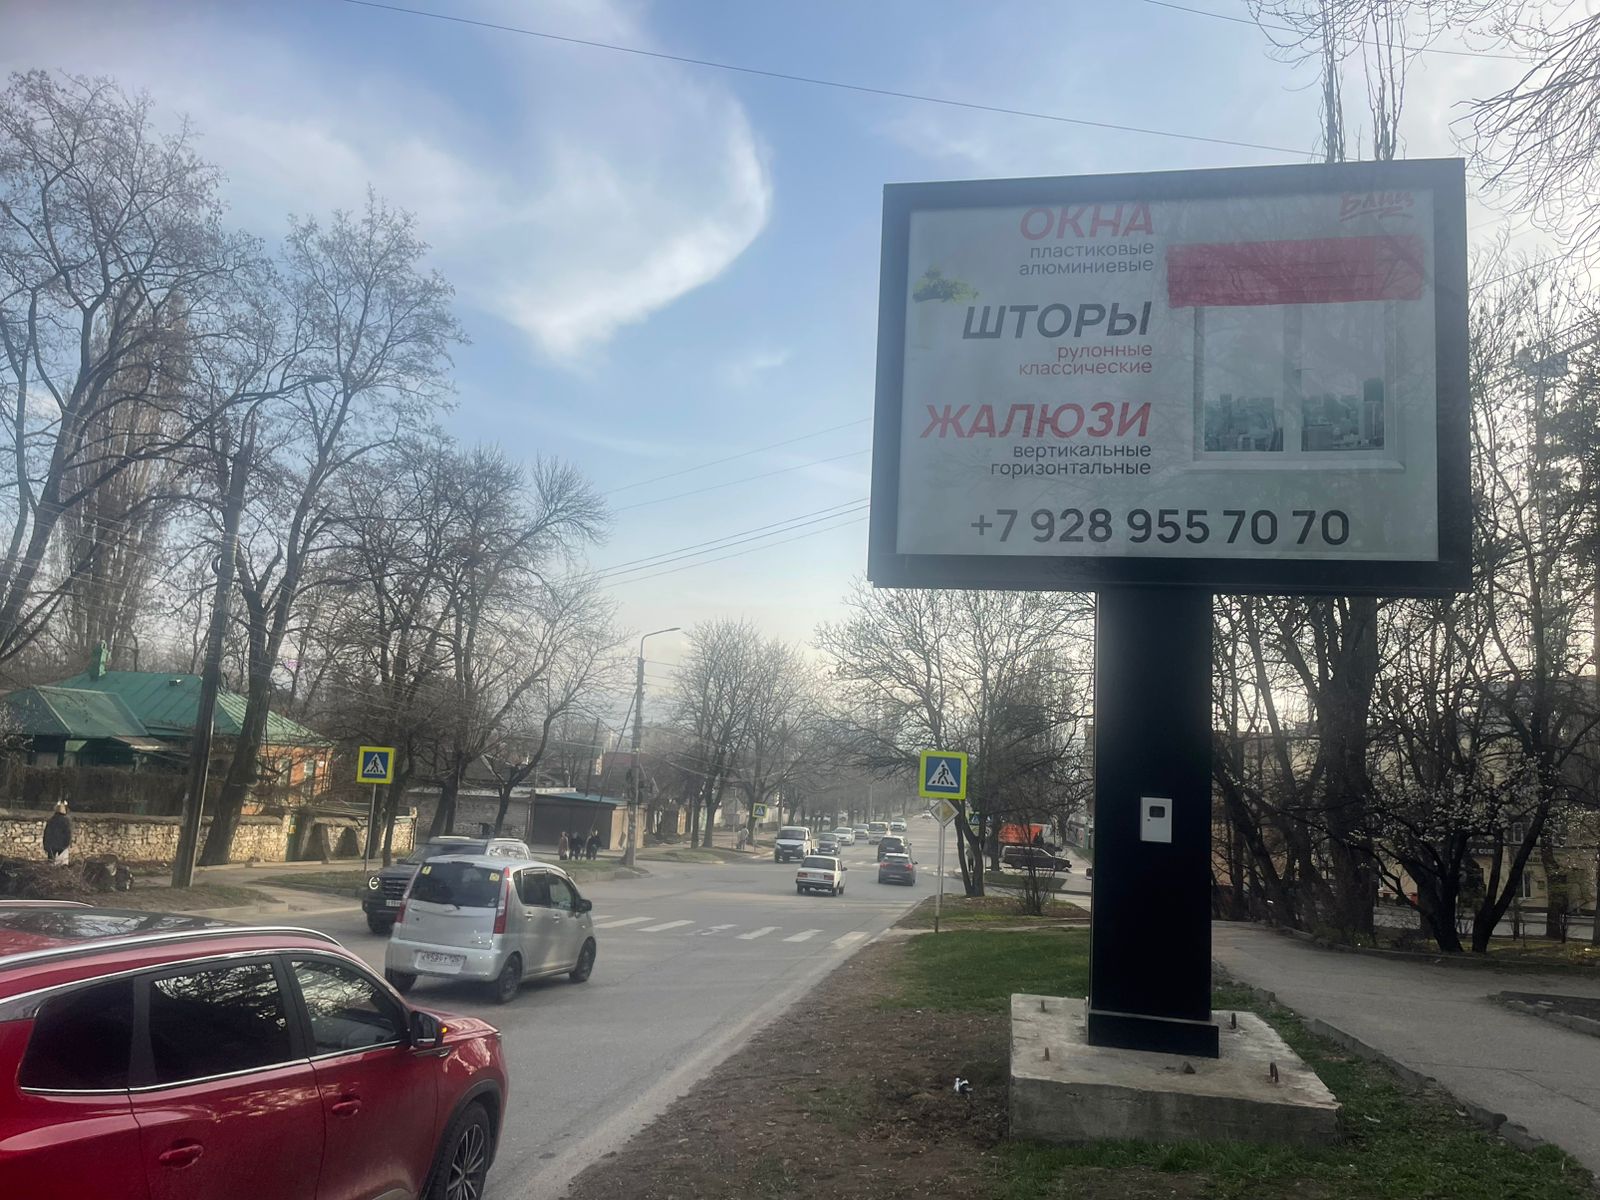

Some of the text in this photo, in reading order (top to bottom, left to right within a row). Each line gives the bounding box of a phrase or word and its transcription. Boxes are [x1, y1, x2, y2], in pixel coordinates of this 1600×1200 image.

[1019, 203, 1155, 241] ОКНА
[1029, 242, 1155, 259] пластиковые
[1019, 259, 1154, 276] алюминиевые
[962, 301, 1152, 340] ШТОРЫ
[1057, 344, 1153, 362] рулонные
[1019, 359, 1153, 376] классические
[920, 401, 1152, 439] ЖАЛЮЗИ
[1013, 443, 1151, 462] вертикальные
[991, 461, 1151, 479] горизонтальные
[970, 507, 1350, 546] +7 928 955 70 70
